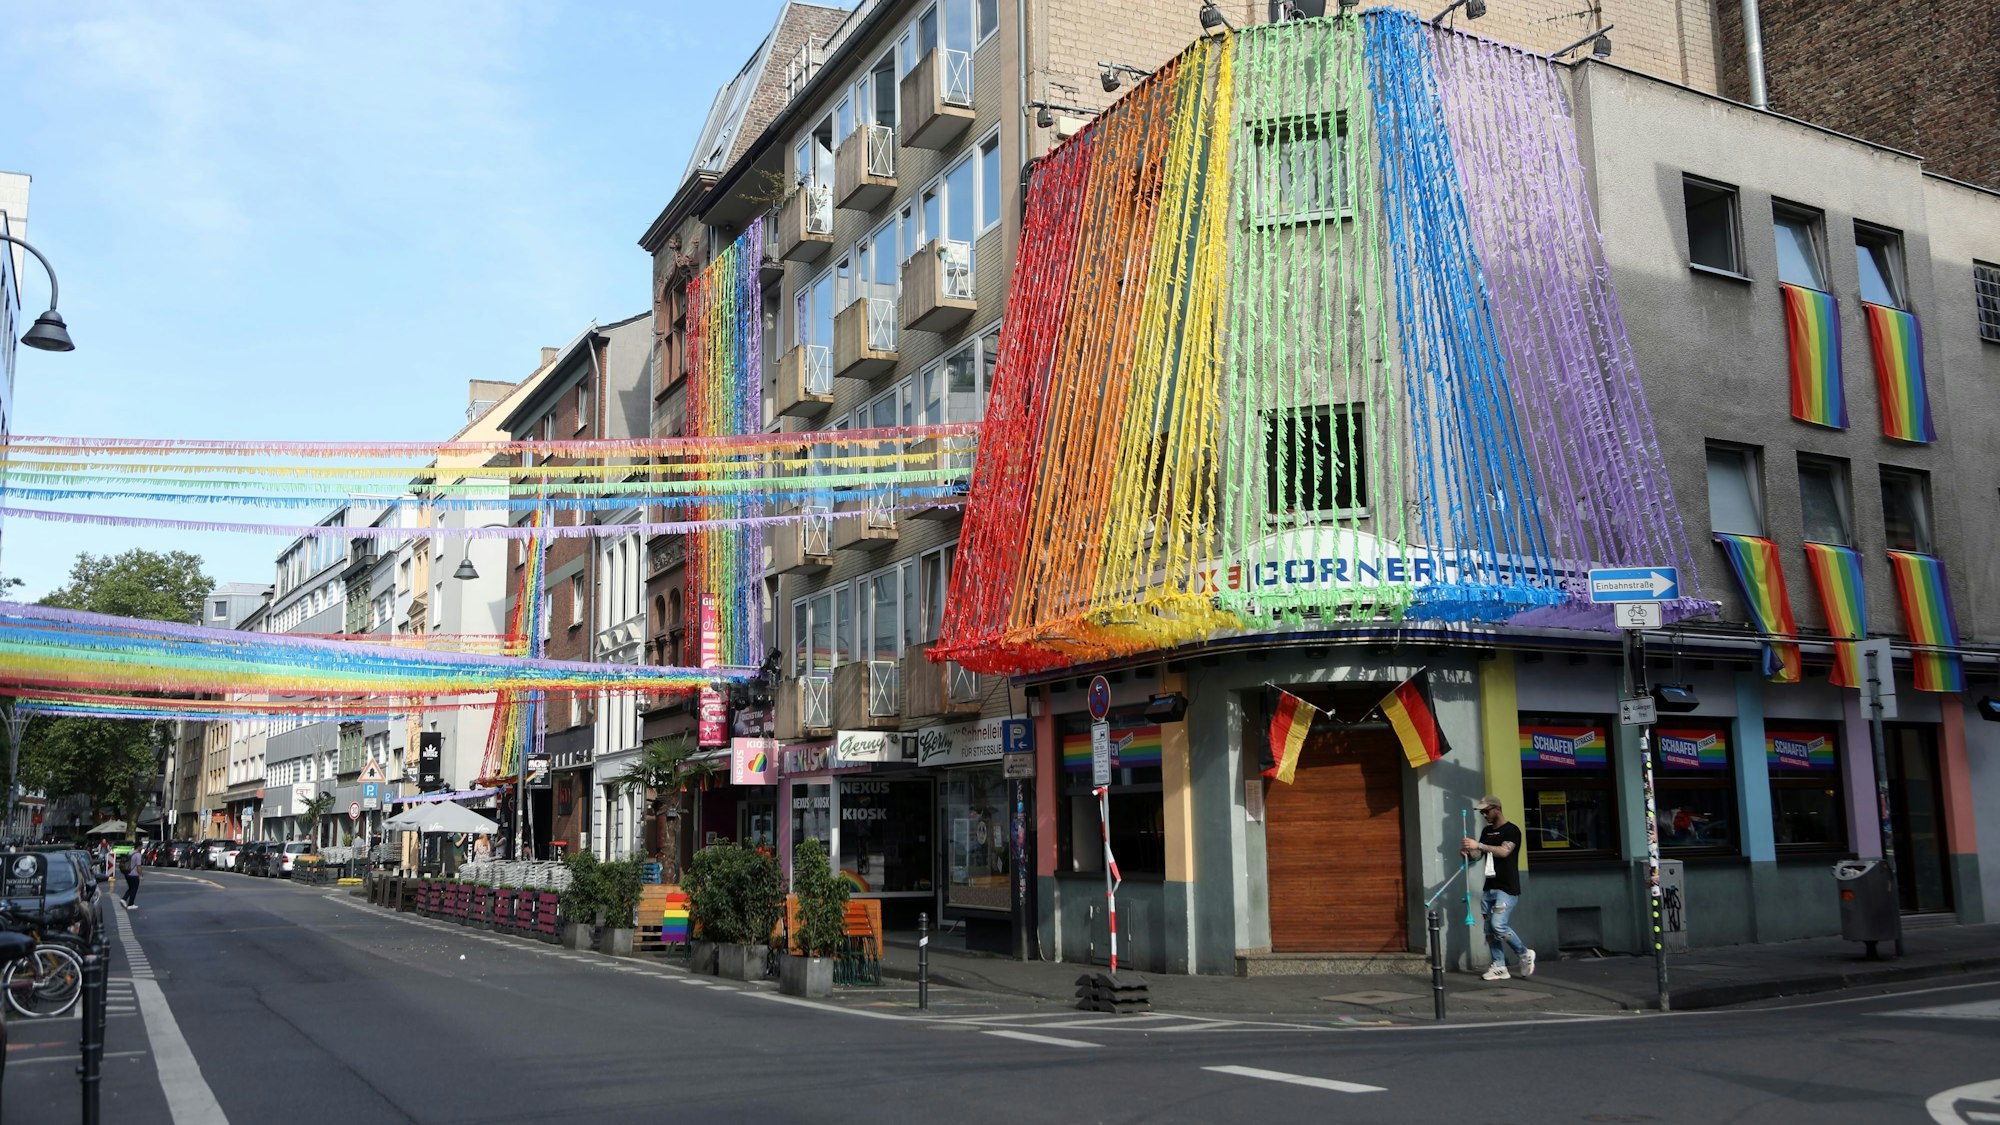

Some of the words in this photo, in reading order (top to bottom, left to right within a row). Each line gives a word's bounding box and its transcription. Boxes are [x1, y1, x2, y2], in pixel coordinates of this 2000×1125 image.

[1254, 557, 1439, 586] CORNER
[1596, 581, 1654, 591] Einbahnstraße
[746, 739, 774, 749] KIOSK
[840, 735, 886, 759] Gerny
[962, 743, 973, 758] FÜR
[1533, 735, 1574, 755] SCHAAFEN
[1661, 737, 1697, 757] SCHAAFEN
[1774, 739, 1808, 758] SCHAAFEN
[736, 750, 744, 783] NEXUS
[783, 746, 818, 774] NEXUS
[841, 782, 890, 795] NEXUS
[793, 797, 809, 809] NEXUS
[814, 796, 830, 809] KIOSK
[842, 808, 887, 820] KIOSK
